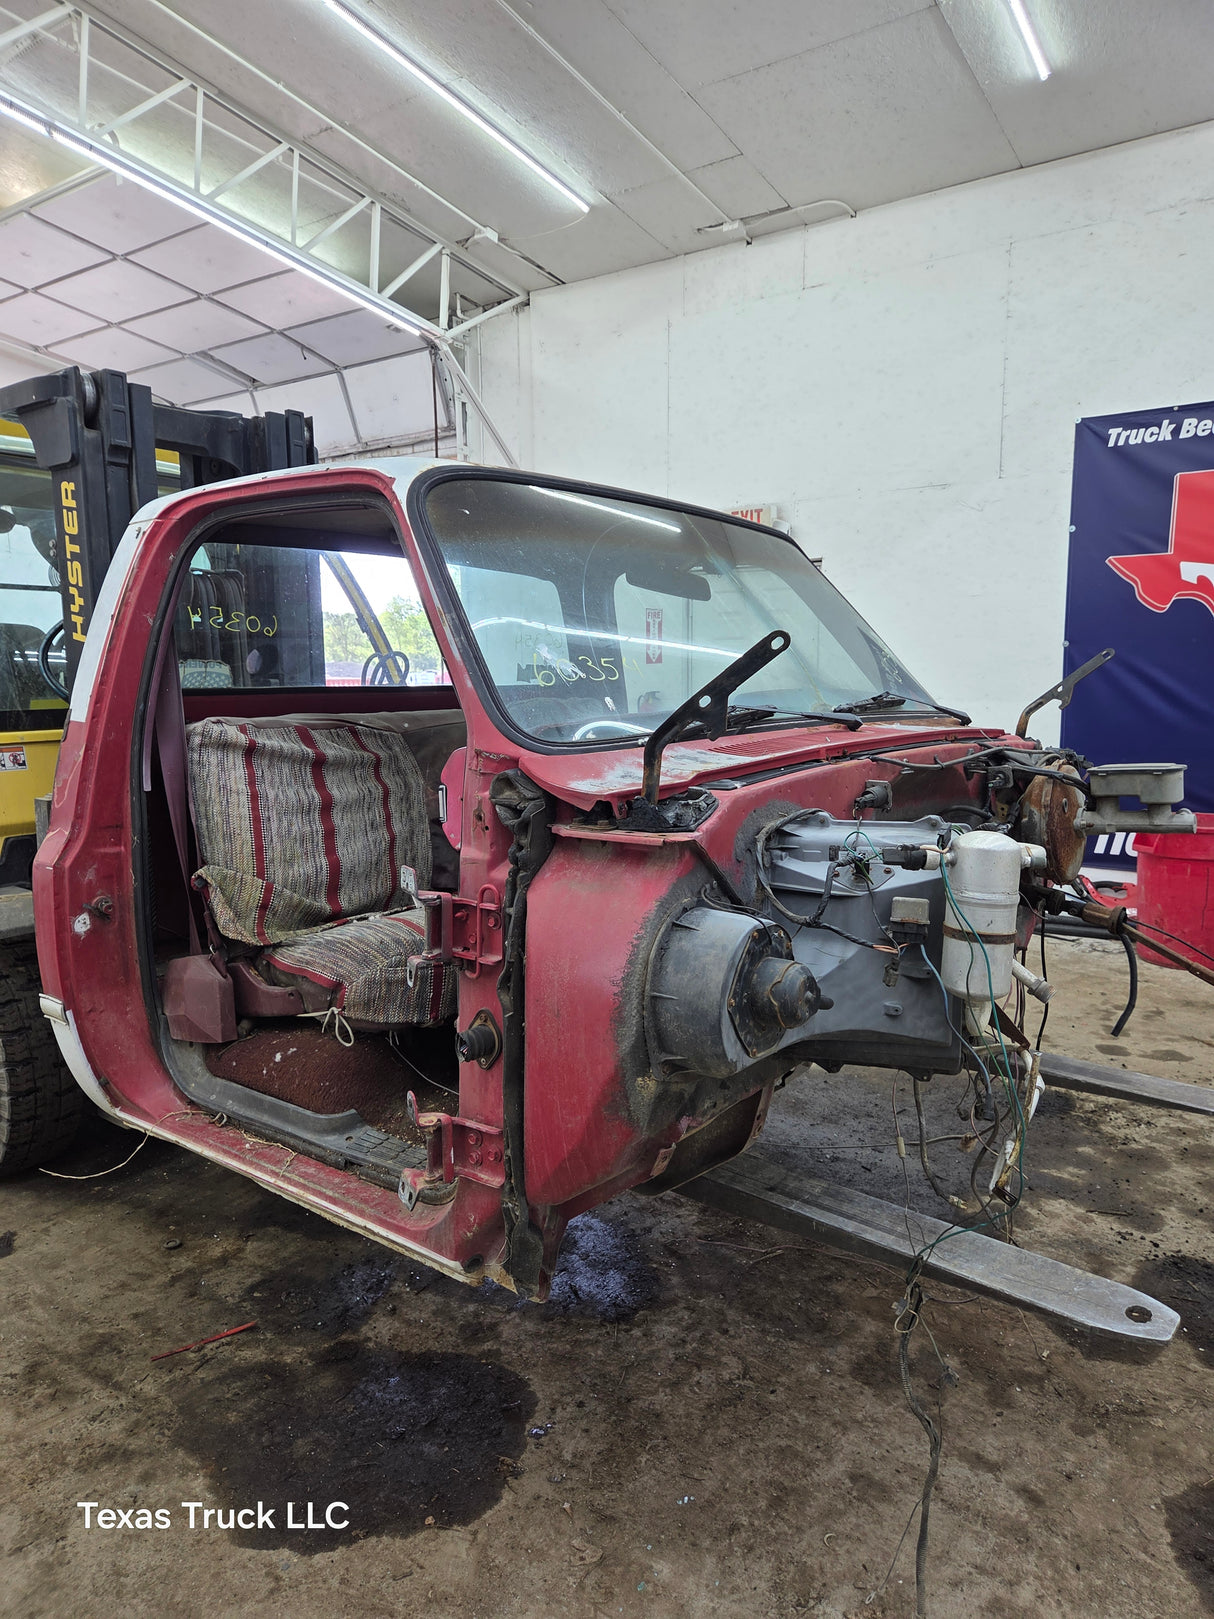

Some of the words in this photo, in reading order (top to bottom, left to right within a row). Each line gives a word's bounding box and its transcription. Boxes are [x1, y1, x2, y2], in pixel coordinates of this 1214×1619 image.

[1107, 419, 1177, 448] Truck
[1178, 417, 1214, 440] Be
[60, 480, 87, 643] HYSTER
[647, 611, 662, 620] FIRE
